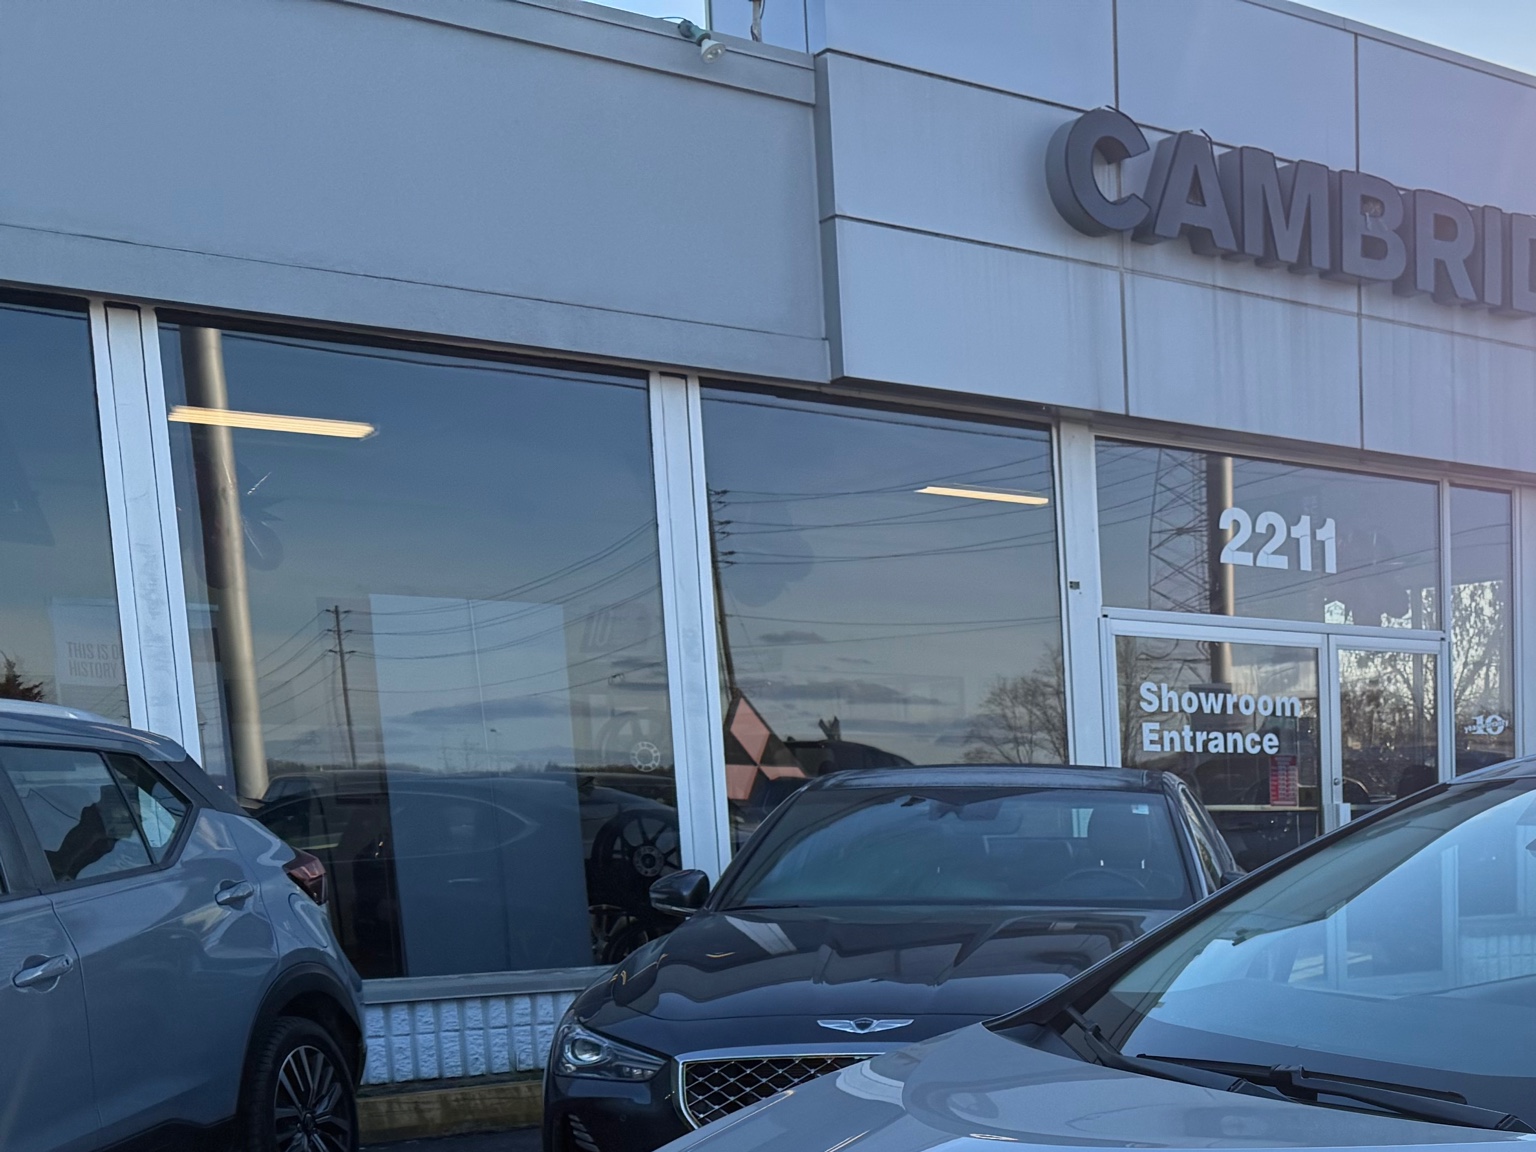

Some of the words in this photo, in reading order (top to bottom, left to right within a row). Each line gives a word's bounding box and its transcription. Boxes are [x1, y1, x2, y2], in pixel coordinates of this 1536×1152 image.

[1219, 507, 1337, 574] 2211
[66, 641, 94, 660] THIS
[97, 643, 109, 661] IS
[69, 660, 117, 679] HISTORY
[1139, 681, 1302, 717] Showroom
[1142, 722, 1280, 755] Entrance
